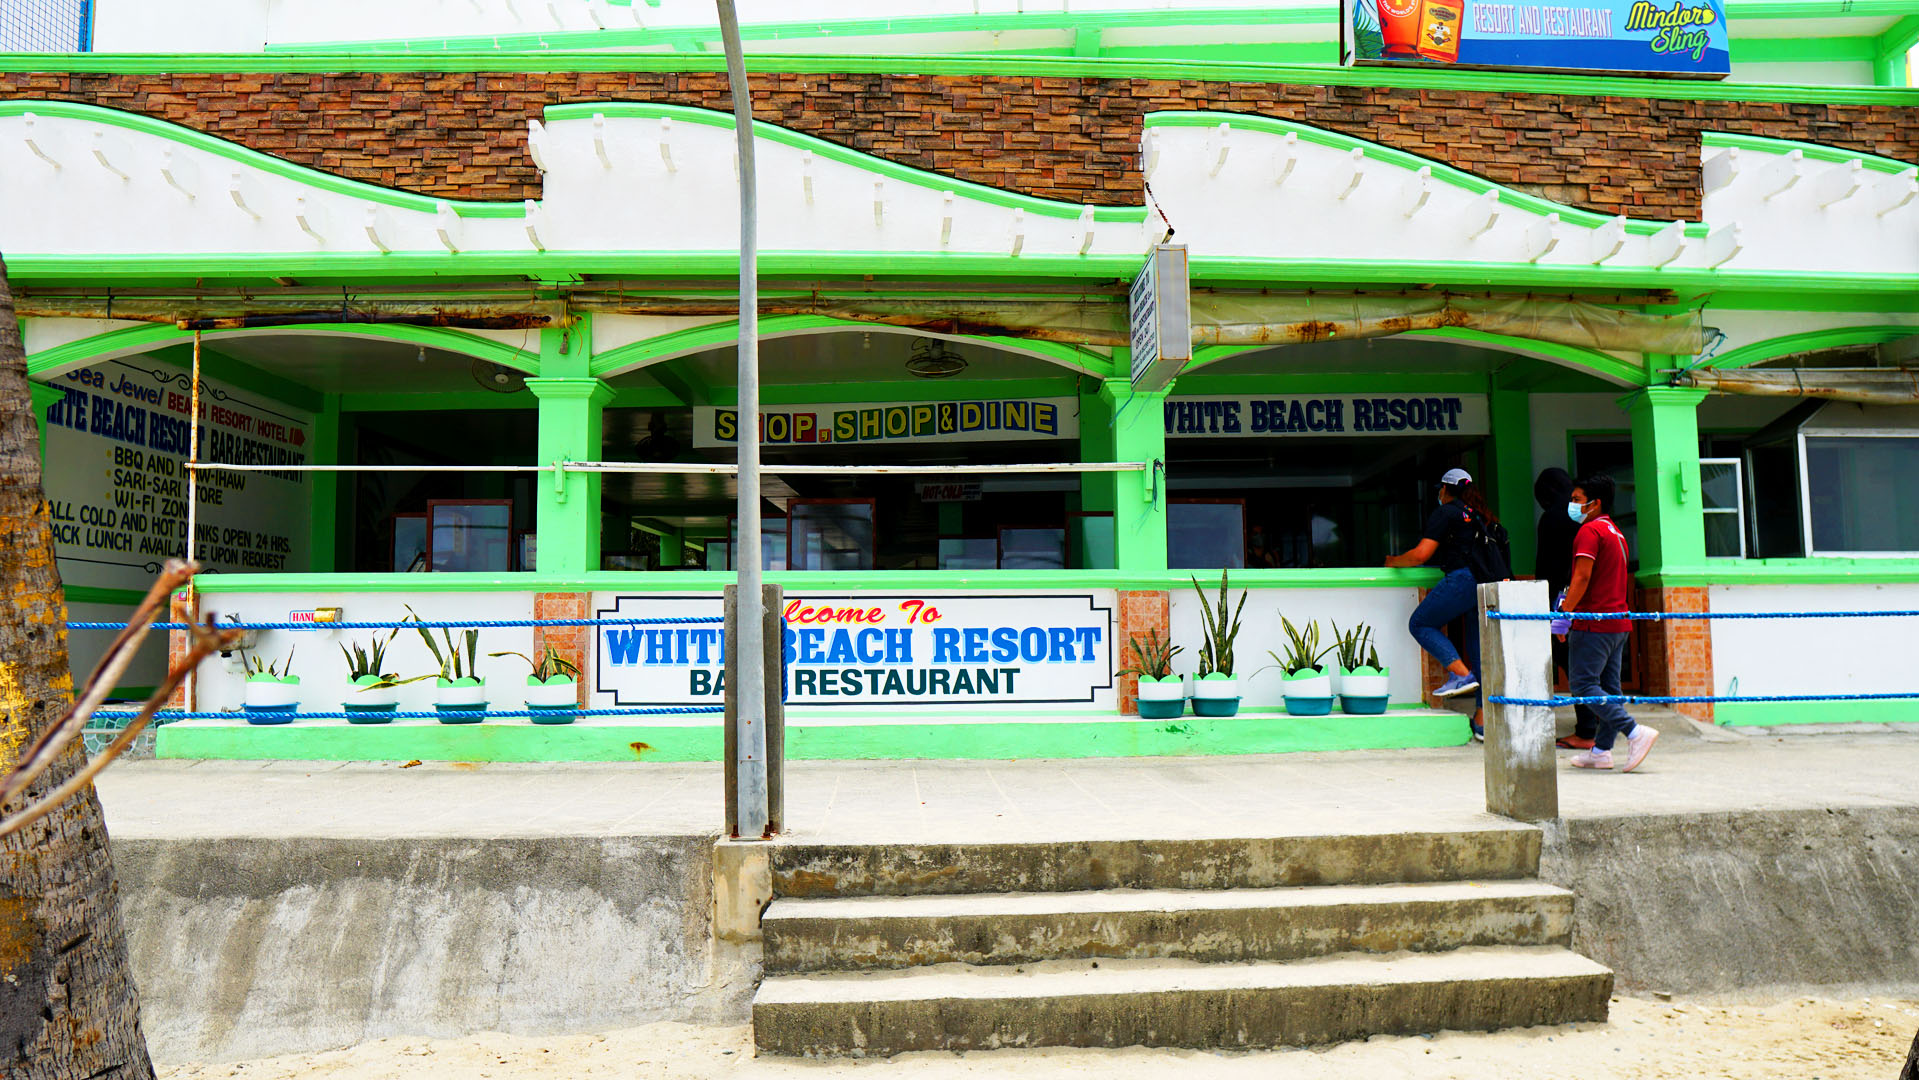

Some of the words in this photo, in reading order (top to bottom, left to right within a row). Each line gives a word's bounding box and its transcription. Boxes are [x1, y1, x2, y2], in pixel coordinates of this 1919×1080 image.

[1474, 3, 1515, 33] RESORT
[1519, 6, 1541, 35] AND
[1543, 8, 1612, 38] RESTAURANT
[1651, 27, 1710, 60] Sling
[110, 373, 164, 407] Jewel
[168, 392, 206, 420] BEAH
[91, 395, 146, 446] BEACH
[149, 411, 205, 460] RESOT
[1250, 400, 1344, 432] BEACH
[1353, 398, 1462, 431] RESORT
[114, 446, 144, 470] BBQ
[146, 454, 175, 477] AND
[114, 468, 181, 498] SARI-SARI
[114, 489, 154, 513] WI-FI
[161, 498, 189, 518] ZON
[80, 505, 116, 527] COLD
[120, 512, 147, 532] AND
[152, 517, 175, 537] HOT
[179, 521, 219, 543] DINKS
[223, 528, 251, 548] OPEN
[256, 532, 267, 550] 24
[86, 528, 132, 552] LUNCH
[211, 544, 238, 564] UPON
[242, 550, 286, 570] REQUEST
[899, 600, 942, 624] To
[604, 629, 725, 666] WHIT
[932, 627, 1102, 665] RESORT
[795, 668, 1020, 696] RESTAURANT
